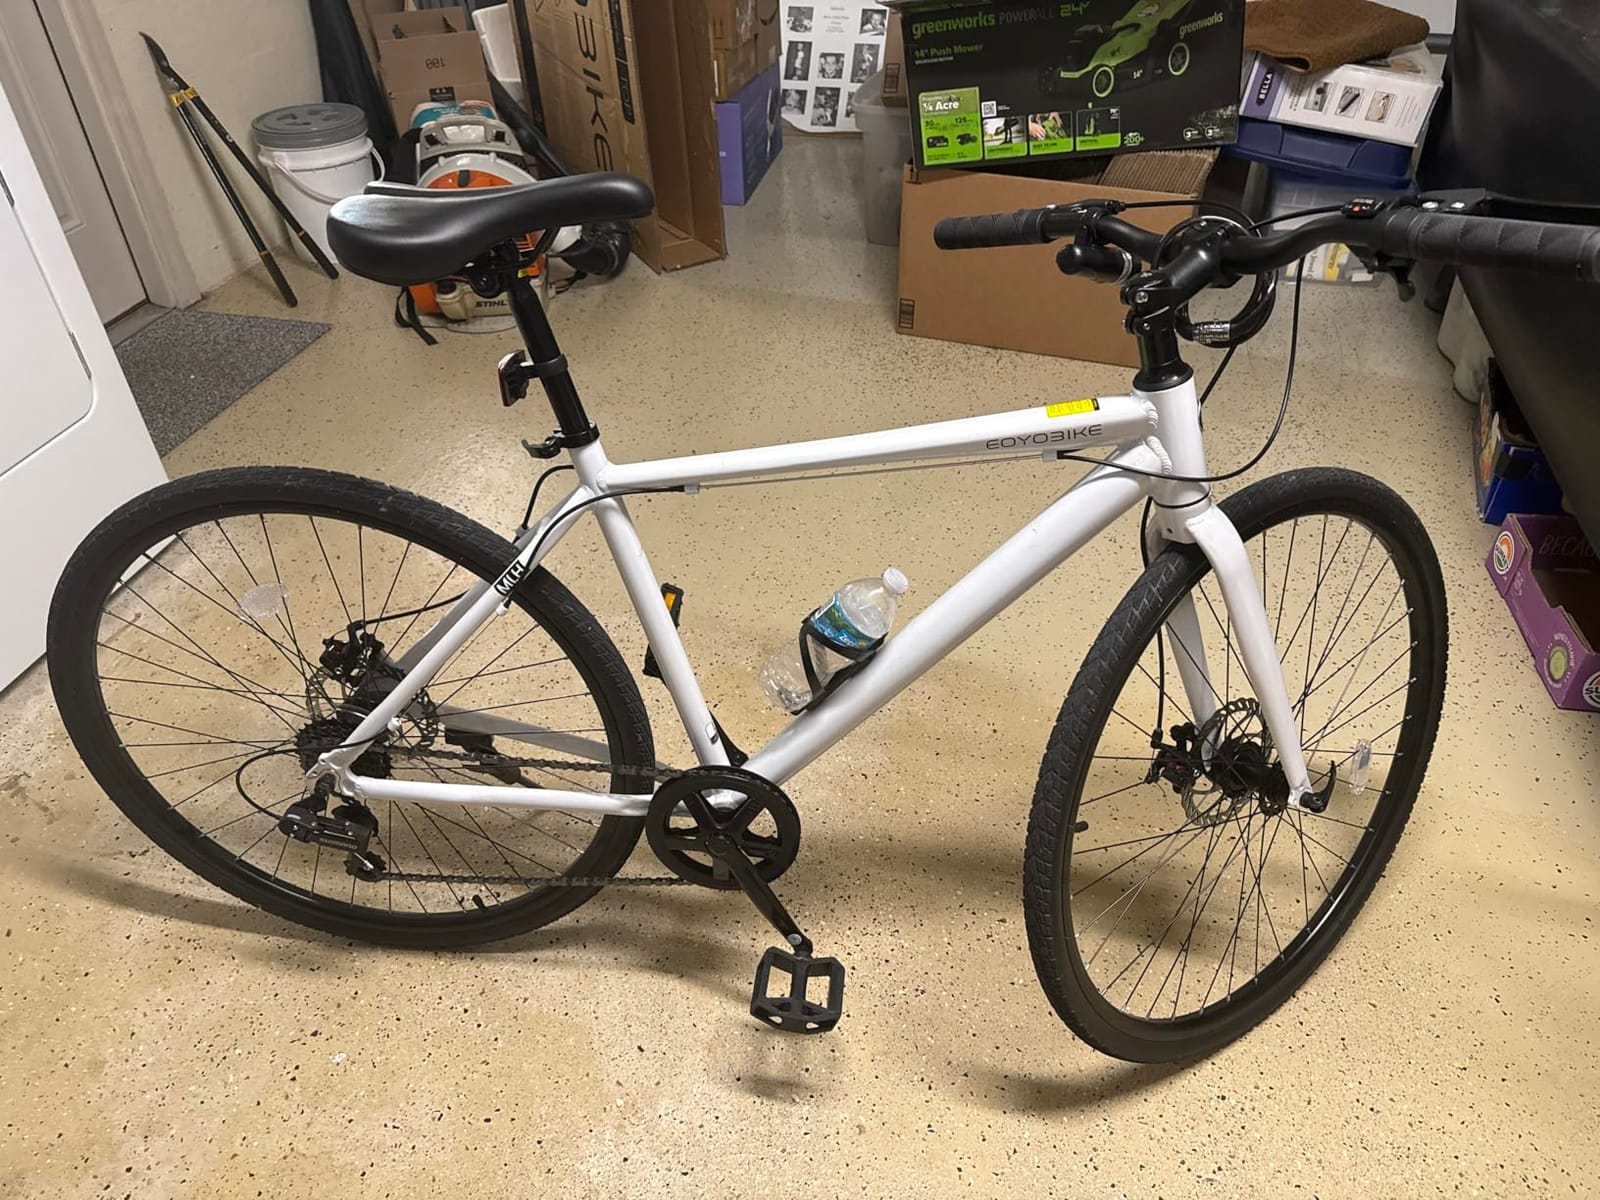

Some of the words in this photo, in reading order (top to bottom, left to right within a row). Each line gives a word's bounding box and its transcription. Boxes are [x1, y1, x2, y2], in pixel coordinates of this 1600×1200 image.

[912, 12, 996, 39] greenworks
[1179, 12, 1224, 38] greenworks
[930, 47, 952, 57] Push
[954, 44, 983, 54] Mower
[574, 0, 614, 172] BIKE
[1259, 73, 1273, 100] BELLA
[935, 101, 960, 111] Acre
[475, 300, 508, 308] STIHL
[985, 423, 1102, 450] EOYOBIKE
[496, 563, 524, 595] MLH
